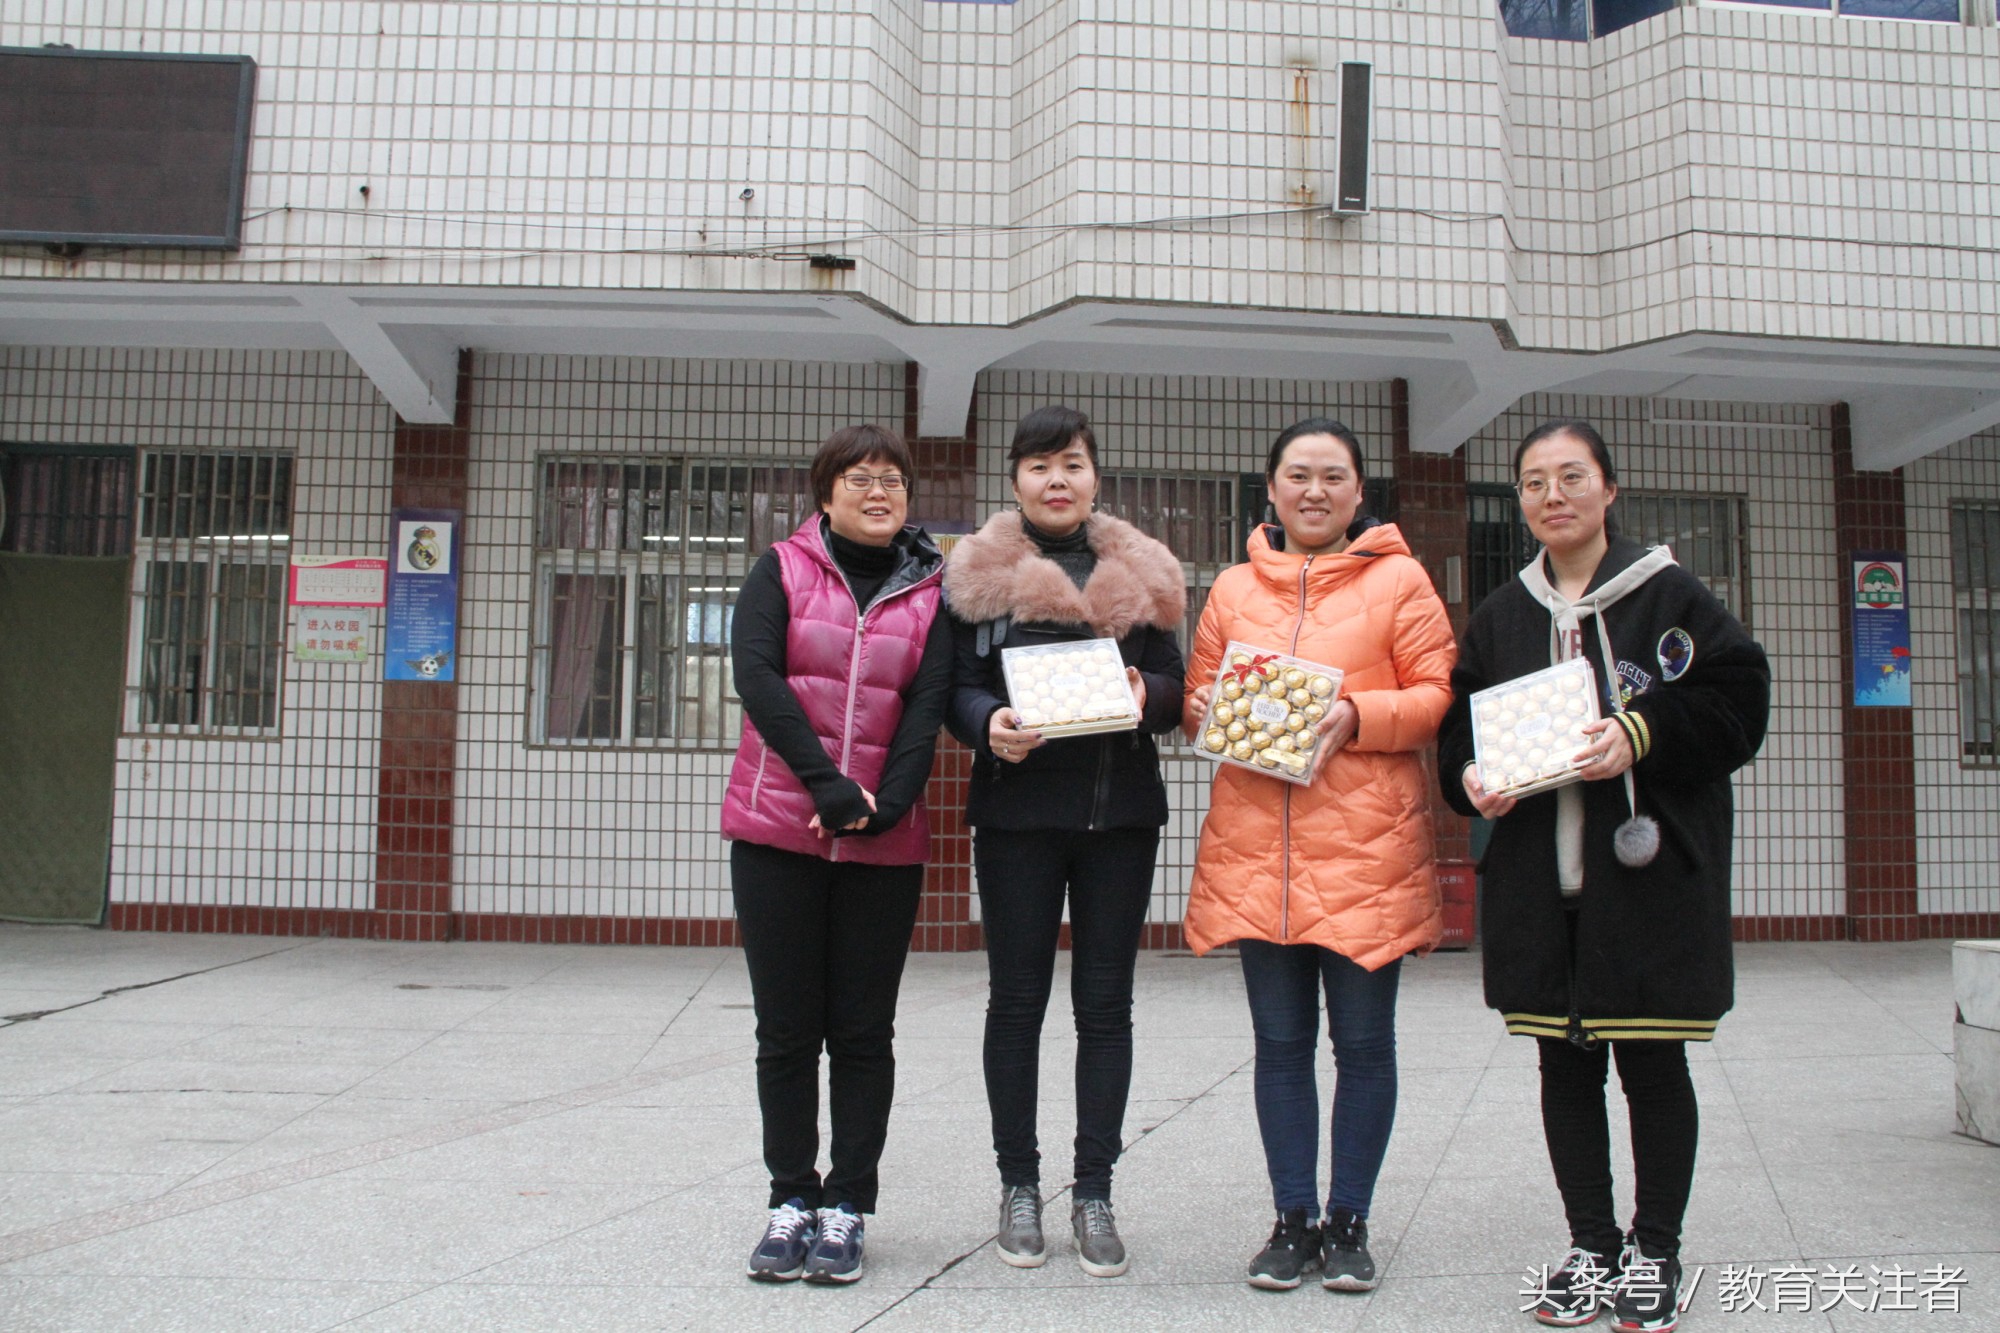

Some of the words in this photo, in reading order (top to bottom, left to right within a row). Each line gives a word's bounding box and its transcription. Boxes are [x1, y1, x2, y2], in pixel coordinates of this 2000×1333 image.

[307, 619, 360, 632] 进入校园
[306, 638, 359, 651] 请勿吸烟
[1616, 660, 1651, 689] AGENT
